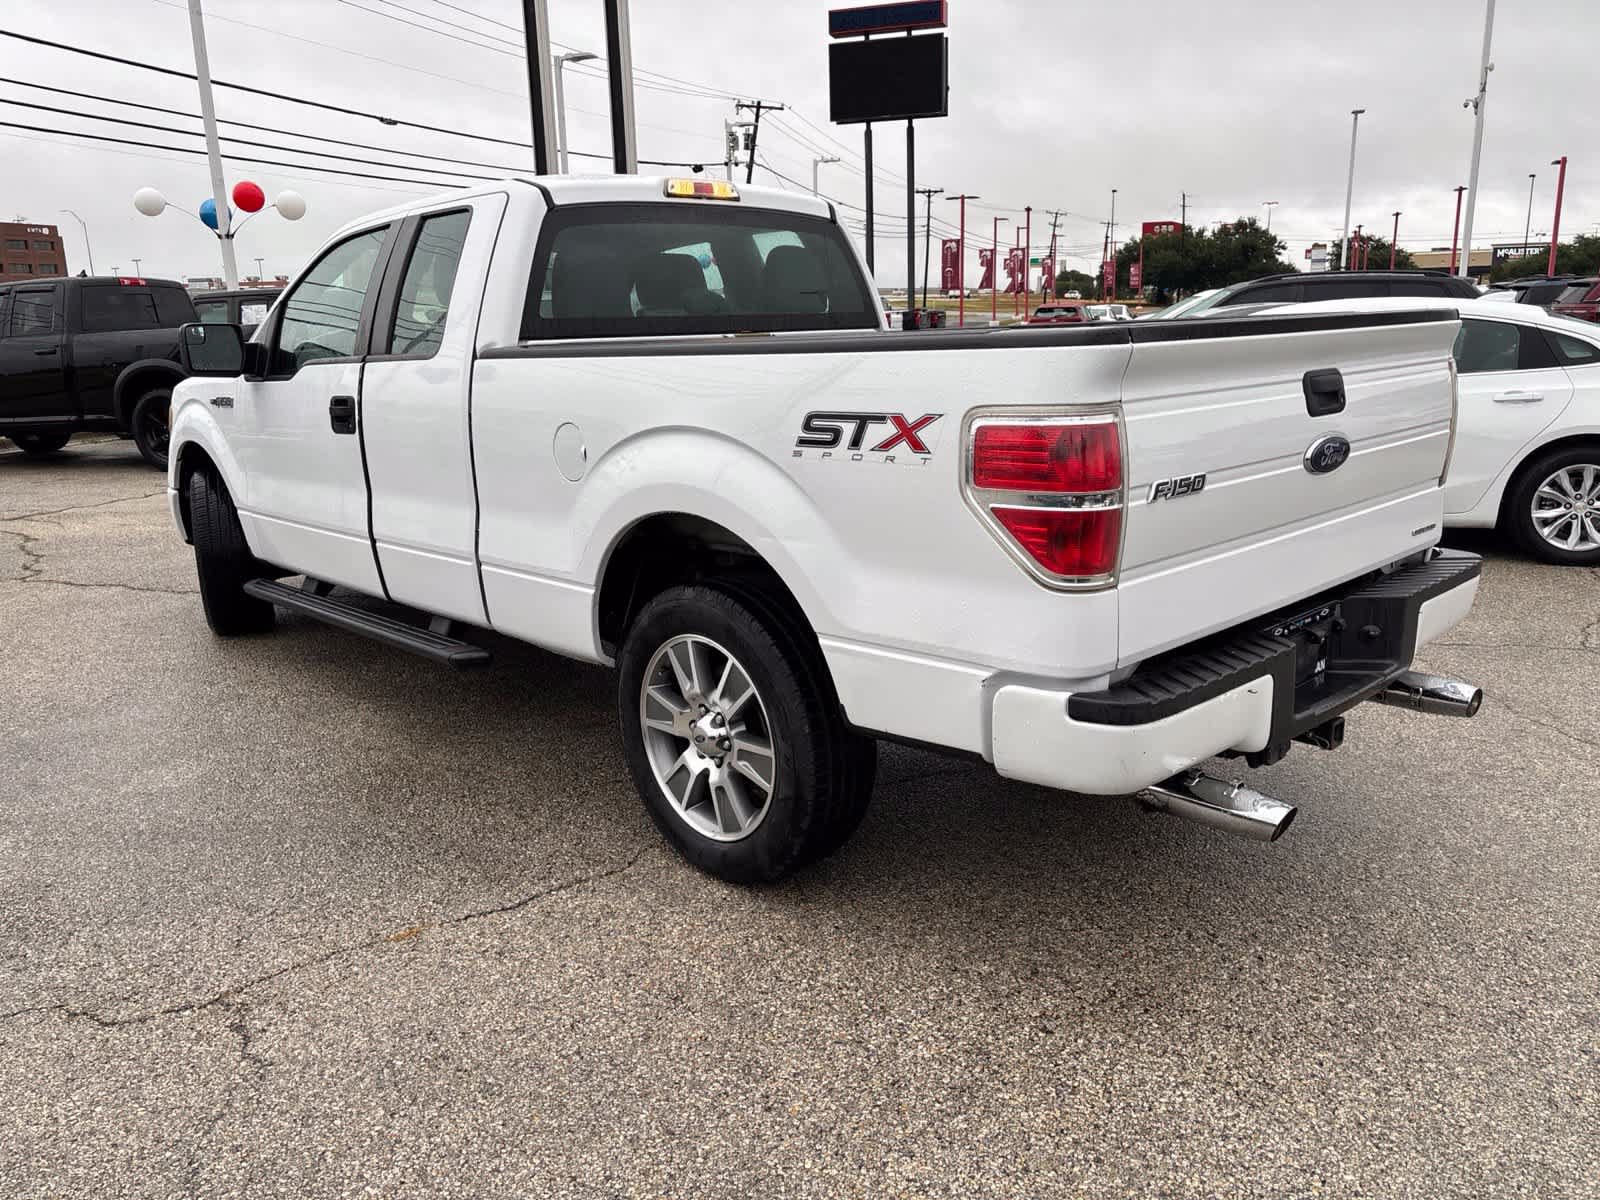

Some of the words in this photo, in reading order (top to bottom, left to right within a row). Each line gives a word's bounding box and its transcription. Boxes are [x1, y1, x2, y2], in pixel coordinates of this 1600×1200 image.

[795, 411, 945, 454] STX
[791, 450, 932, 465] SPORT
[1147, 473, 1206, 504] F-150
